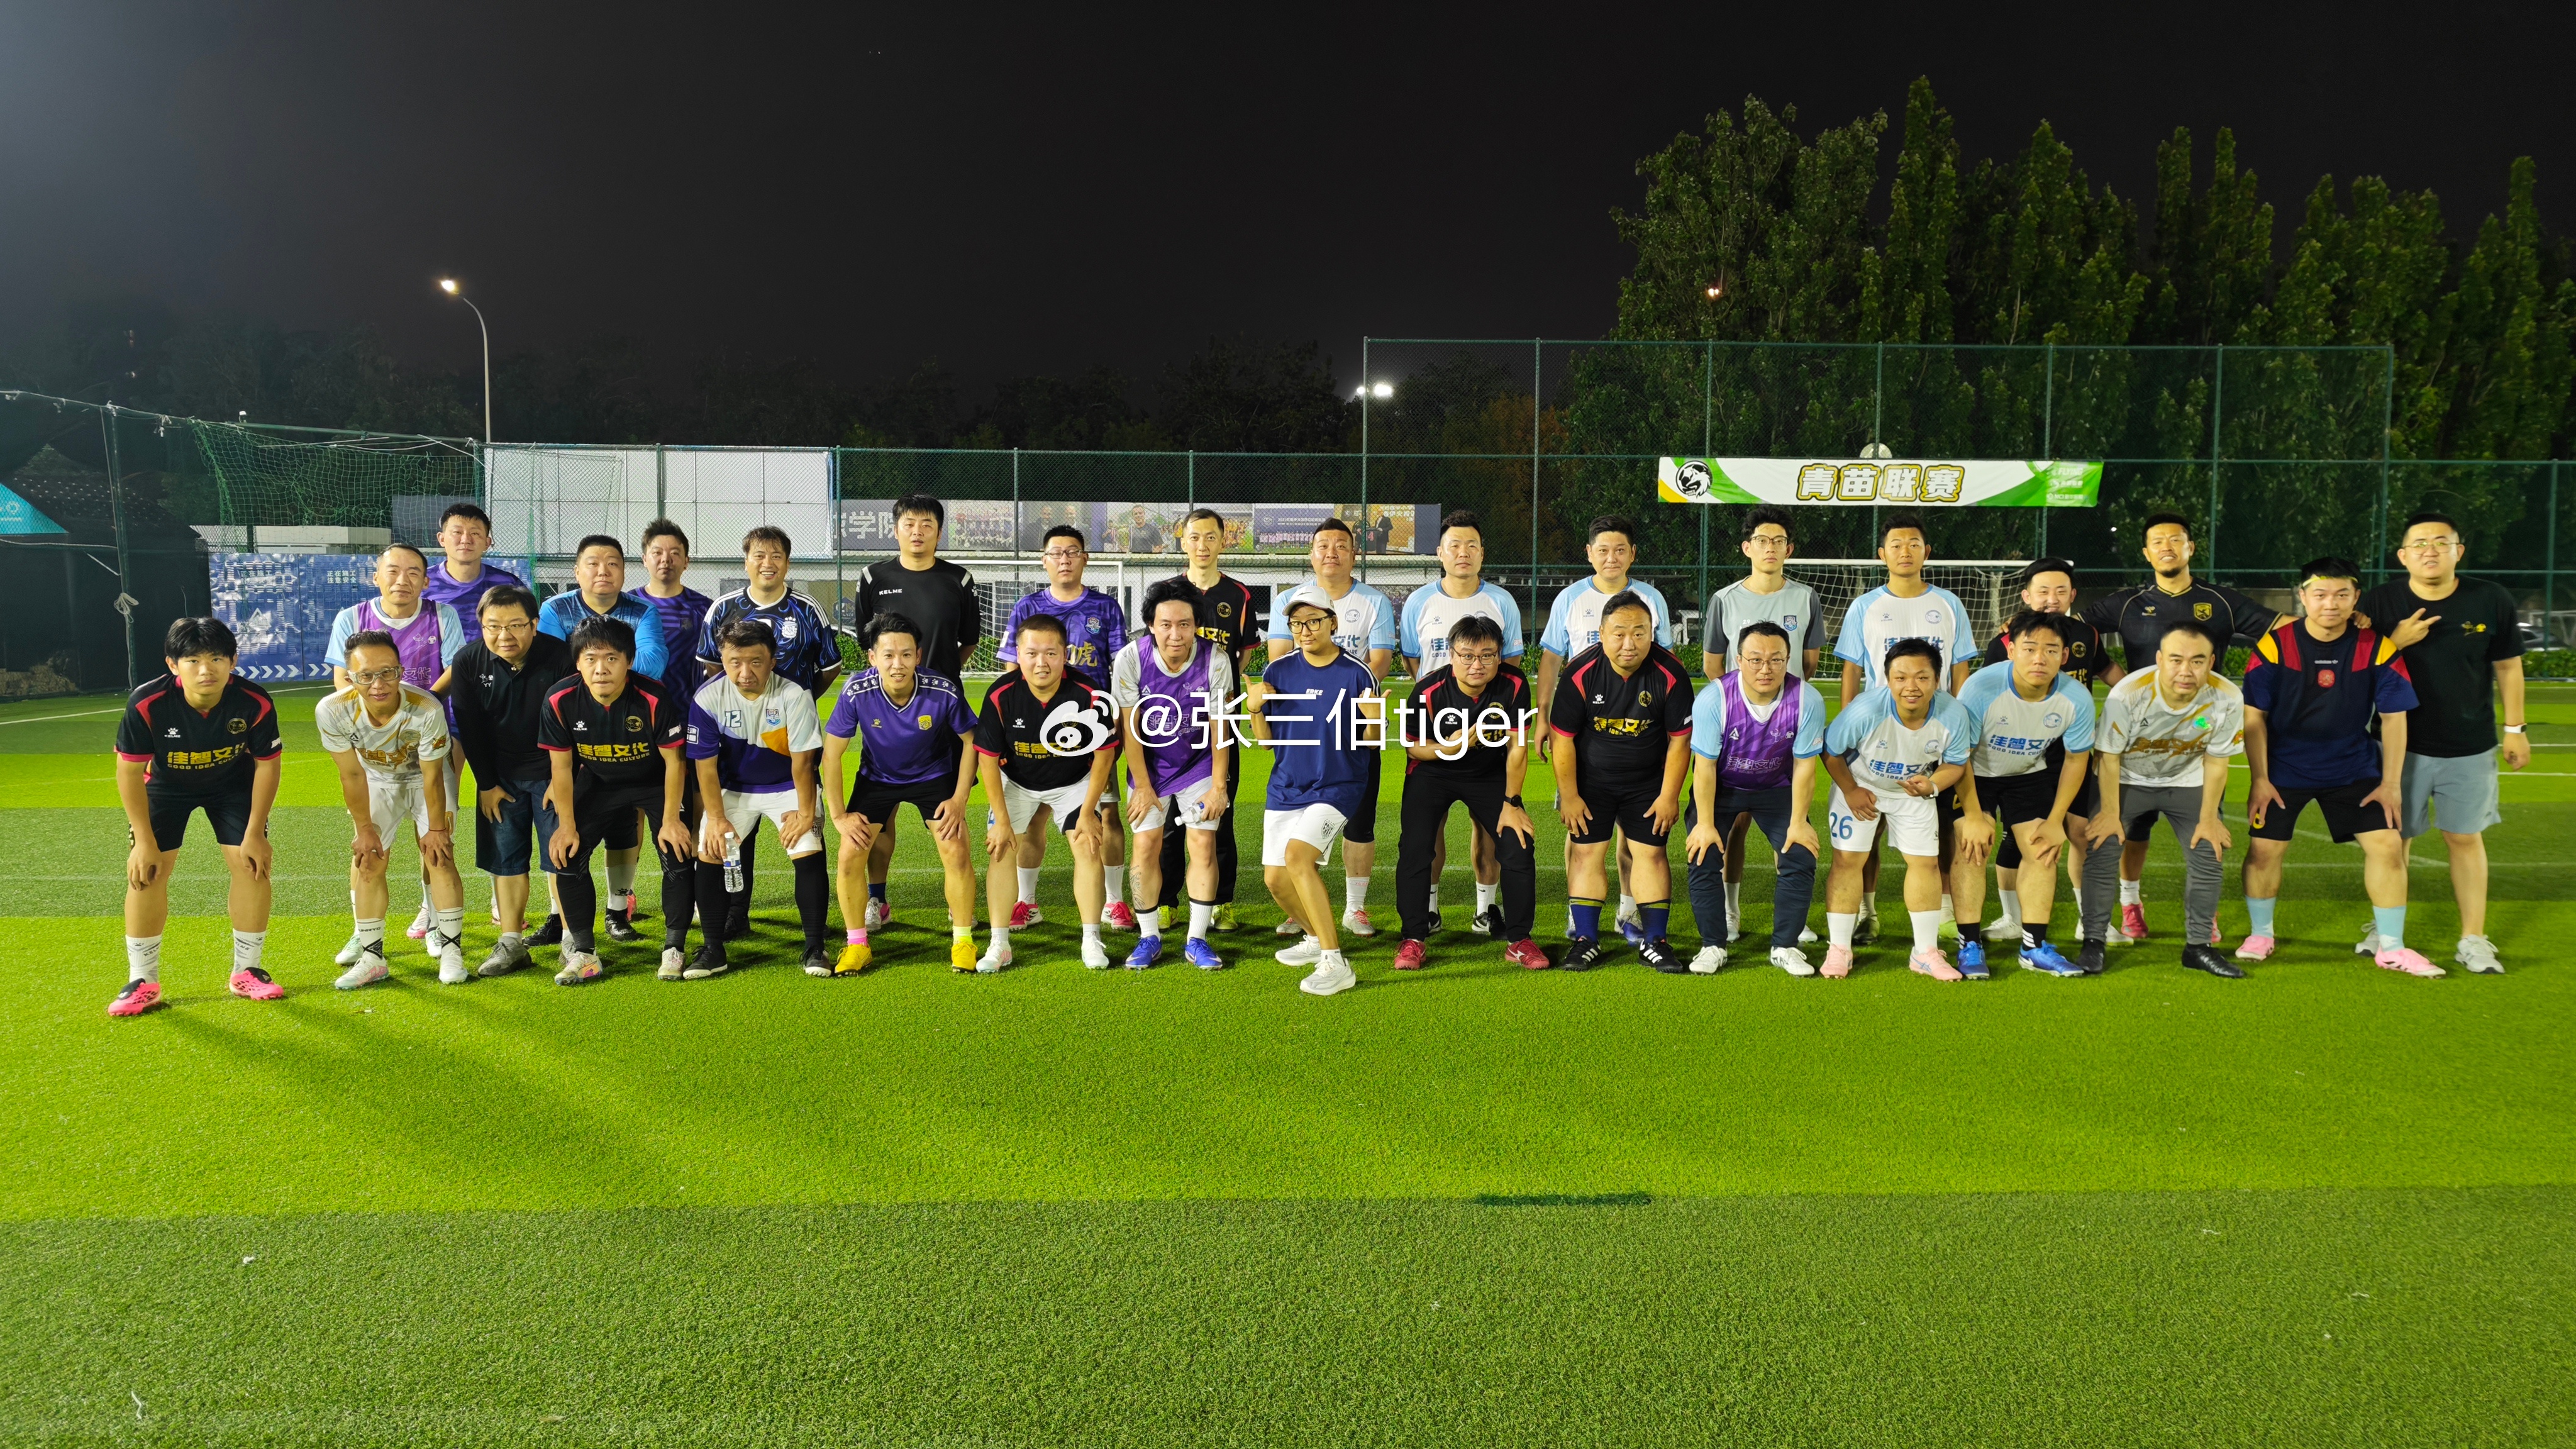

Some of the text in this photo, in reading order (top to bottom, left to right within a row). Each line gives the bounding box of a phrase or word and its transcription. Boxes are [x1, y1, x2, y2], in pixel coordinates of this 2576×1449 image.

[1797, 464, 1965, 502] 青苗联赛
[1306, 688, 1324, 696] ERKE
[724, 709, 741, 728] 12
[577, 741, 650, 758] 佳智文化
[1829, 812, 1853, 840] 26
